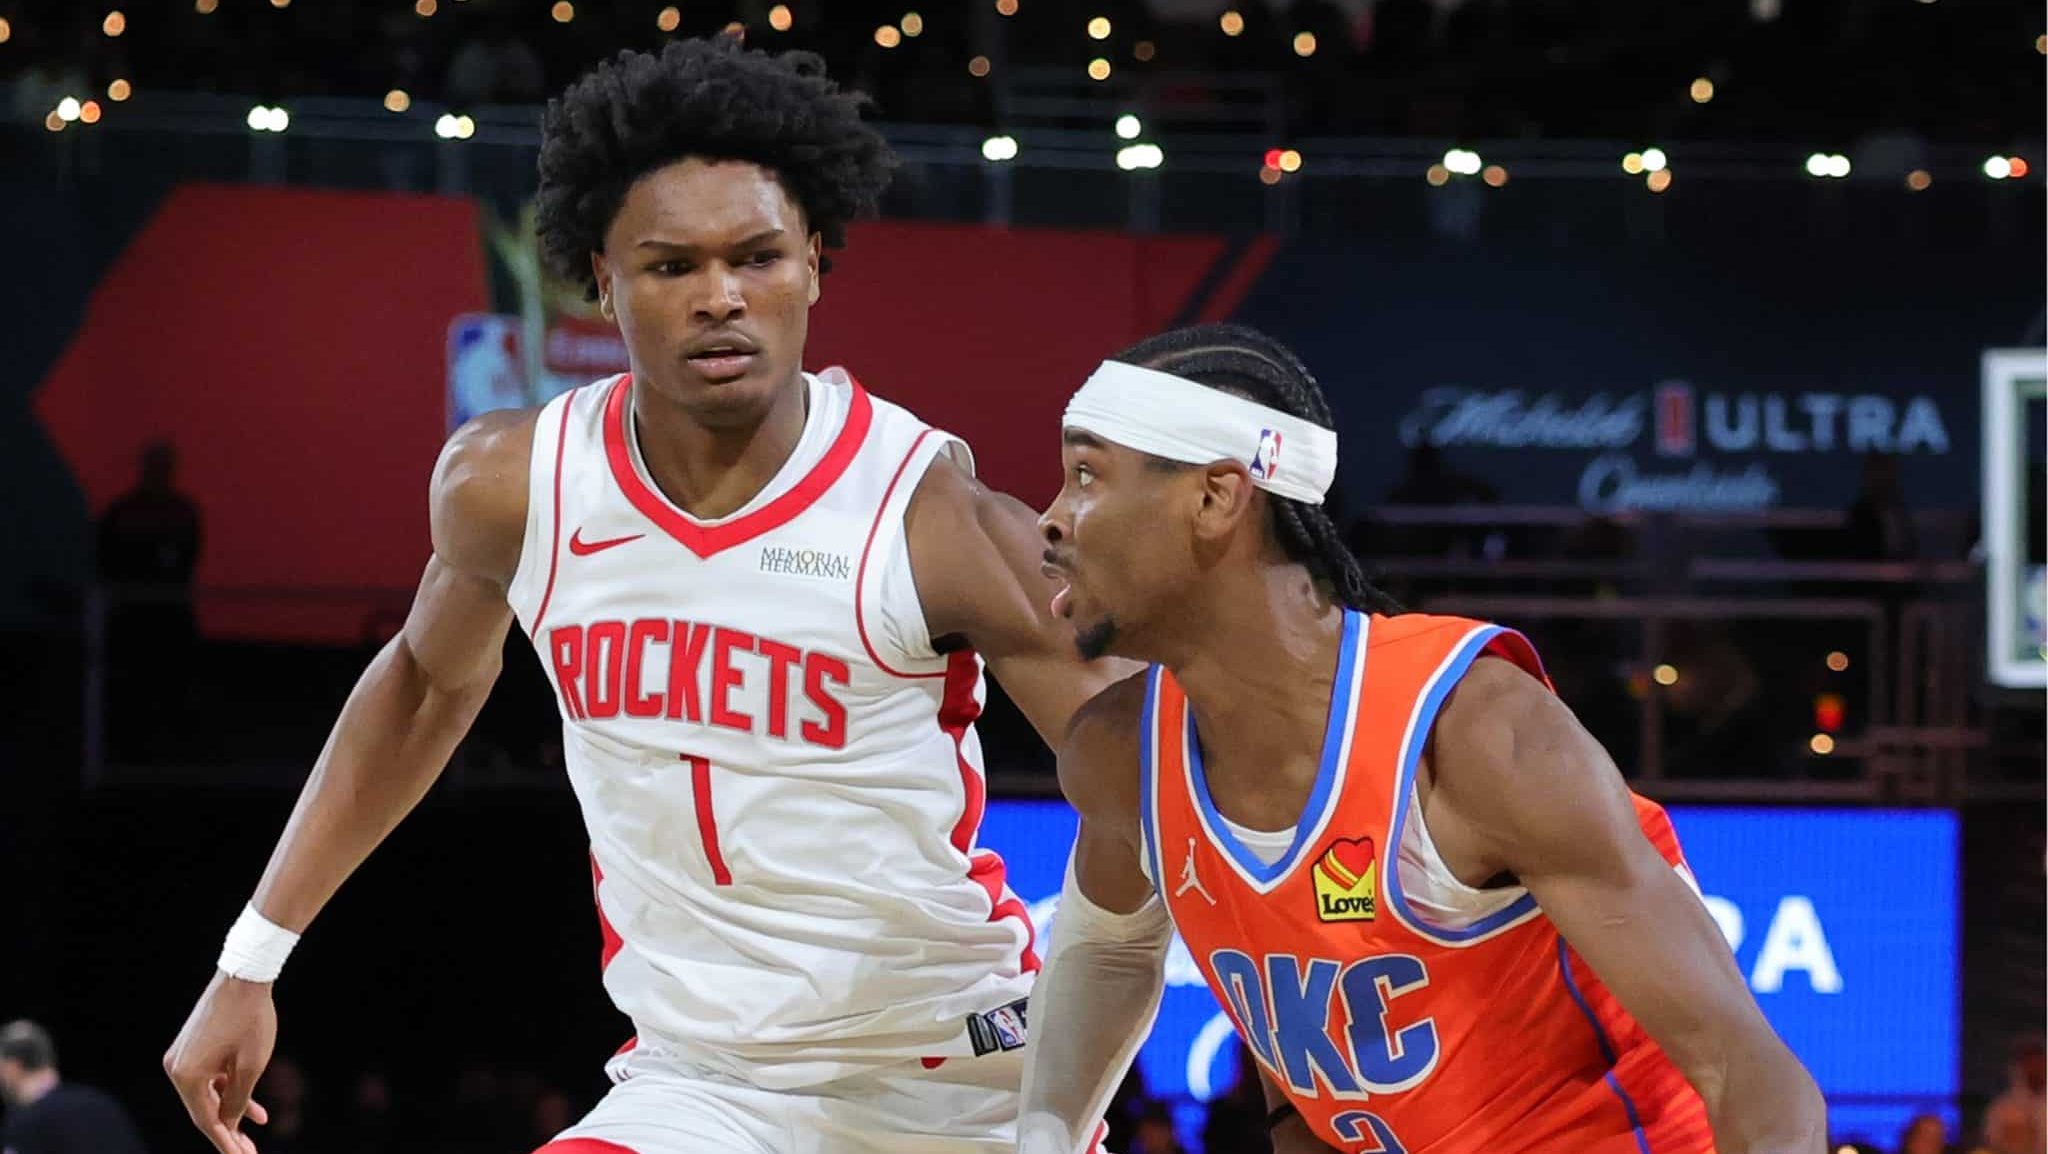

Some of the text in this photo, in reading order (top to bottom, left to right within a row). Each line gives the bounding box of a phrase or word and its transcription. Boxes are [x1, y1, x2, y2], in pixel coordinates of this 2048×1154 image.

[1706, 393, 1950, 453] ULTRA
[760, 546, 850, 570] MEMORIAL
[760, 558, 850, 579] HERMANN
[550, 617, 851, 750] ROCKETS
[679, 754, 733, 887] 1
[1210, 949, 1440, 1101] OKC
